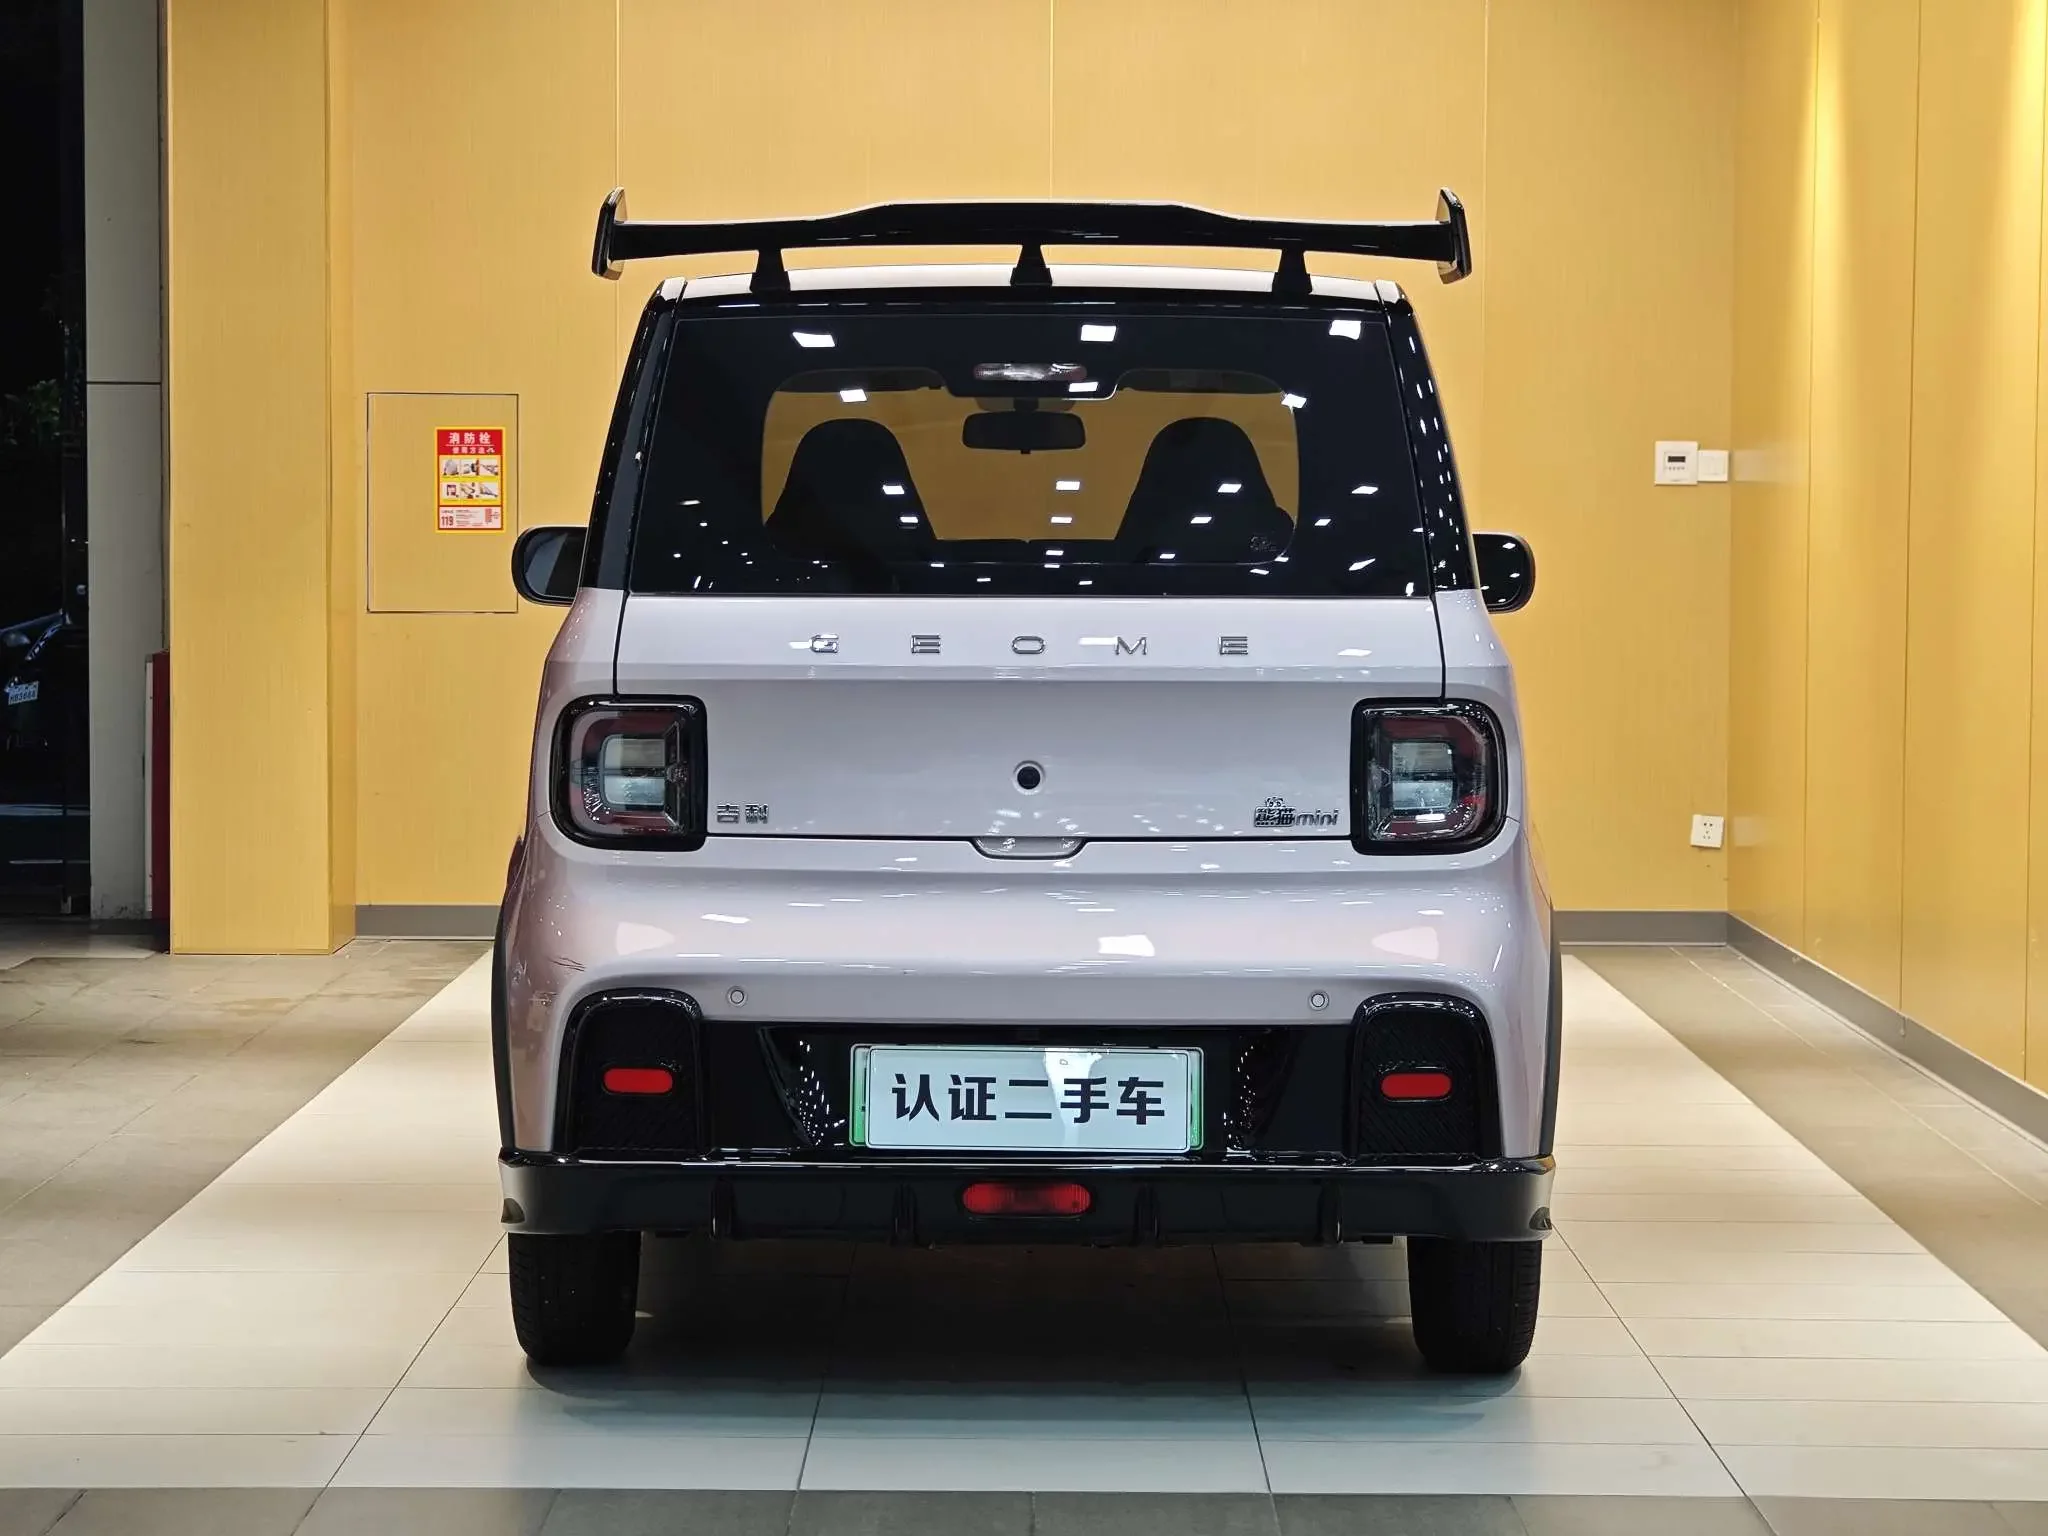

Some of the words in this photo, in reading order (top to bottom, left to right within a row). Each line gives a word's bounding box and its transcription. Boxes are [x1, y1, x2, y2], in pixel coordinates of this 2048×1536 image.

[441, 516, 454, 526] 119
[810, 633, 1249, 656] GEOME
[892, 1073, 1166, 1125] 认证二手车
